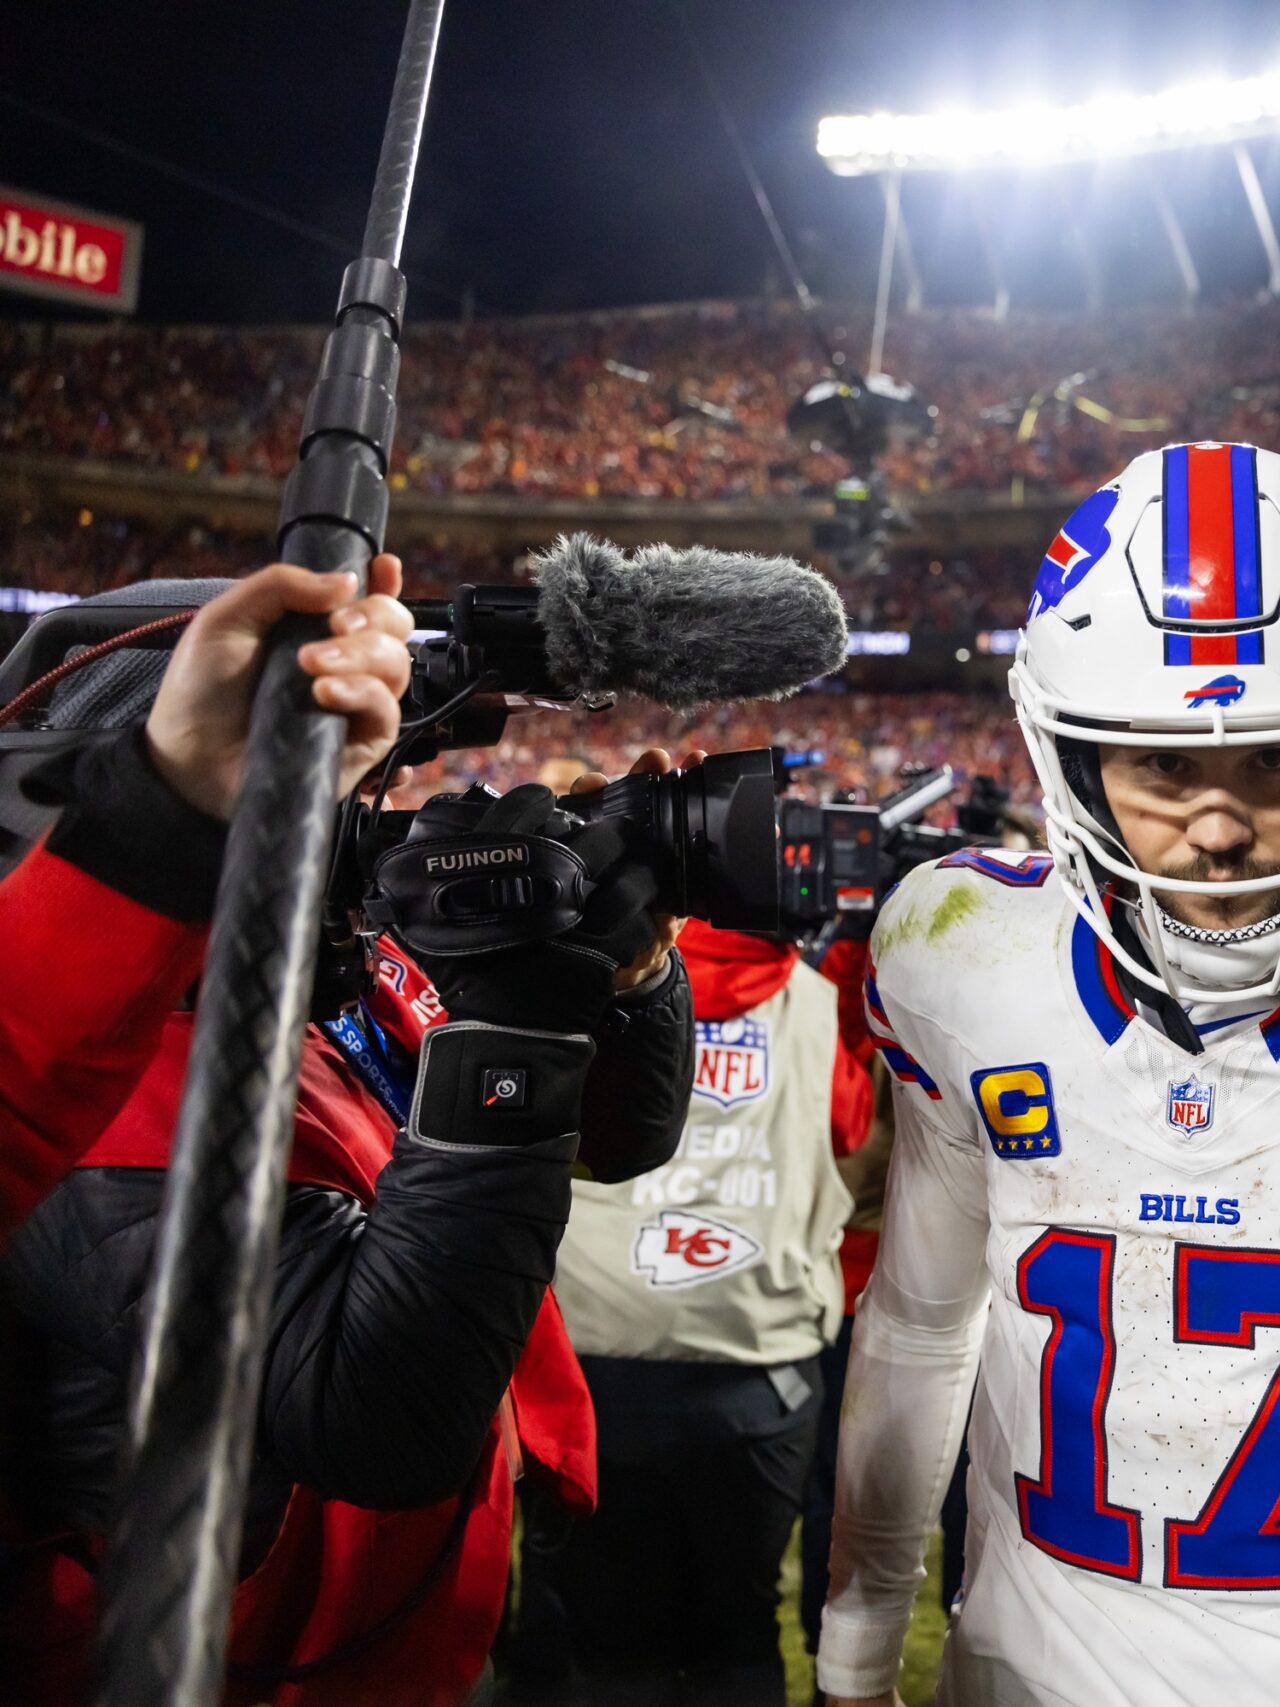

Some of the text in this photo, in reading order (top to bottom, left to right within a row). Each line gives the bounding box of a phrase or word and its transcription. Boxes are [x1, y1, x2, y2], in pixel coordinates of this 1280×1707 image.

[427, 848, 523, 872] FUJINON
[696, 1049, 760, 1094] NFL
[979, 1069, 1049, 1135] C
[1173, 1101, 1206, 1127] NFL
[676, 1124, 772, 1161] EDIA
[1139, 1193, 1241, 1225] BILLS
